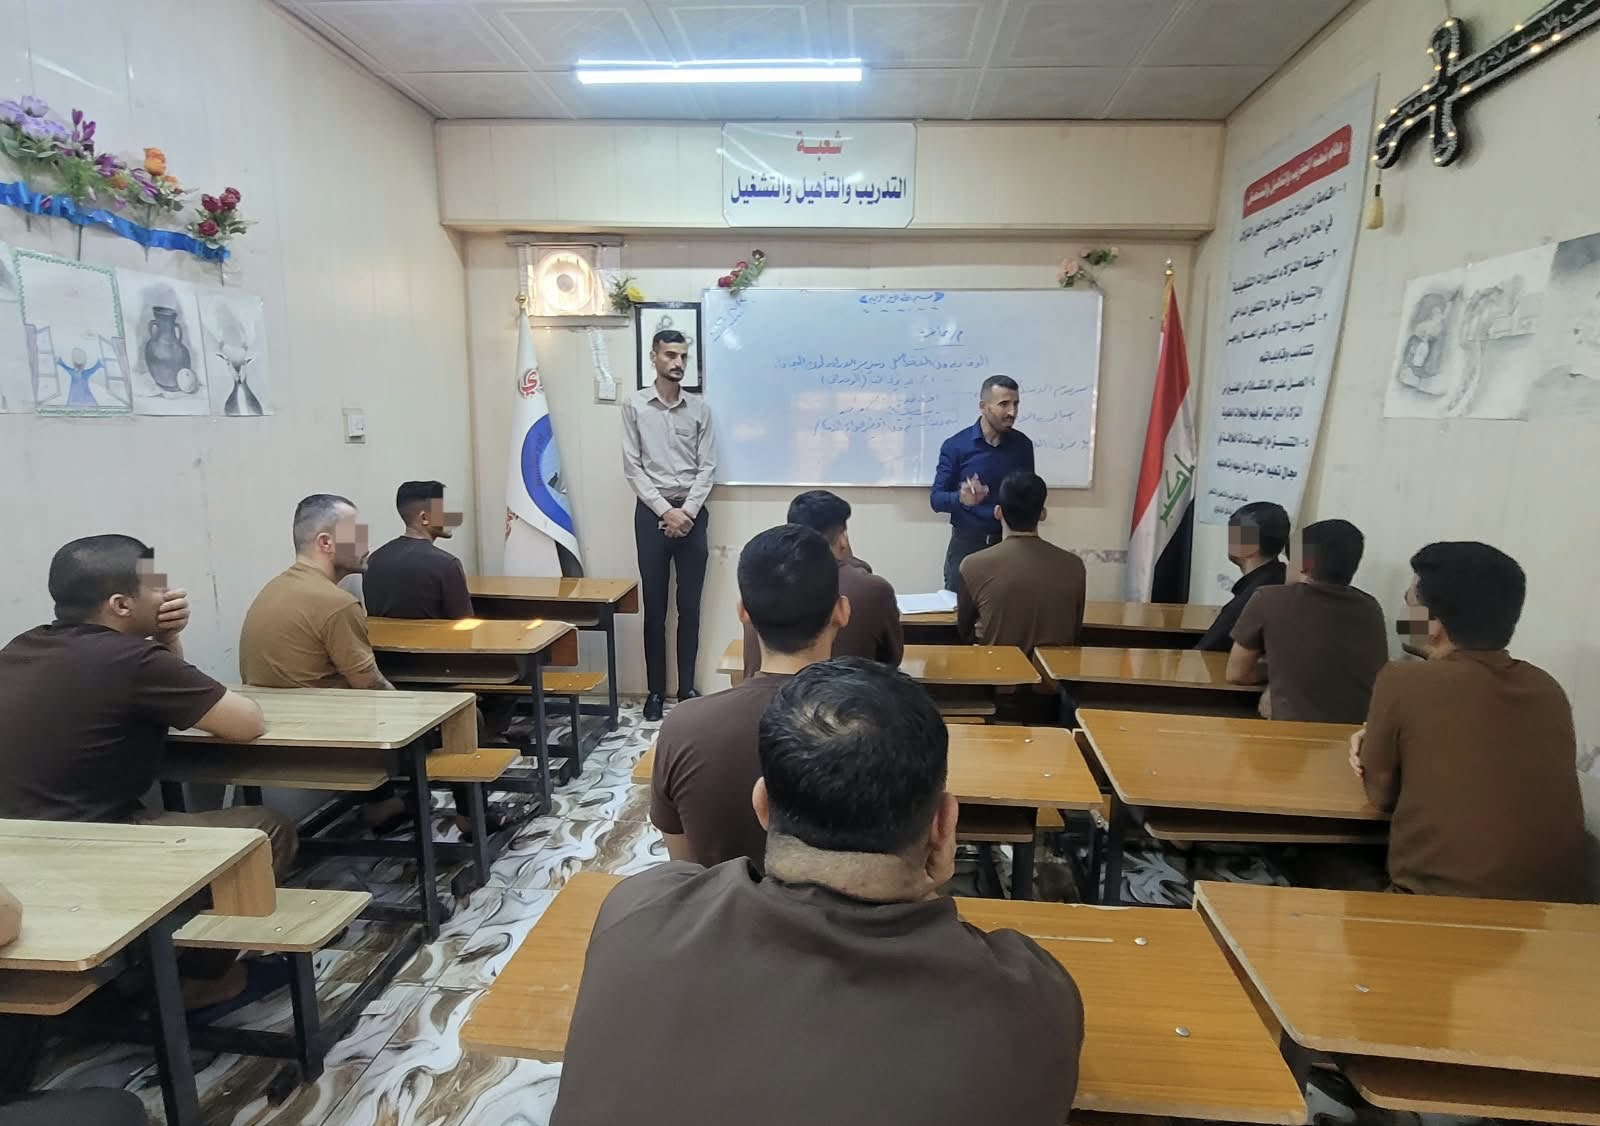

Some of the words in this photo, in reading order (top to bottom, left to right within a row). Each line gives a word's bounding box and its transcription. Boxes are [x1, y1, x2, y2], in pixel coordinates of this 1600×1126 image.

[796, 130, 842, 161] شعبة
[730, 173, 792, 204] والتشغيل
[795, 172, 851, 204] والتأهيل
[855, 176, 907, 205] التدريب
